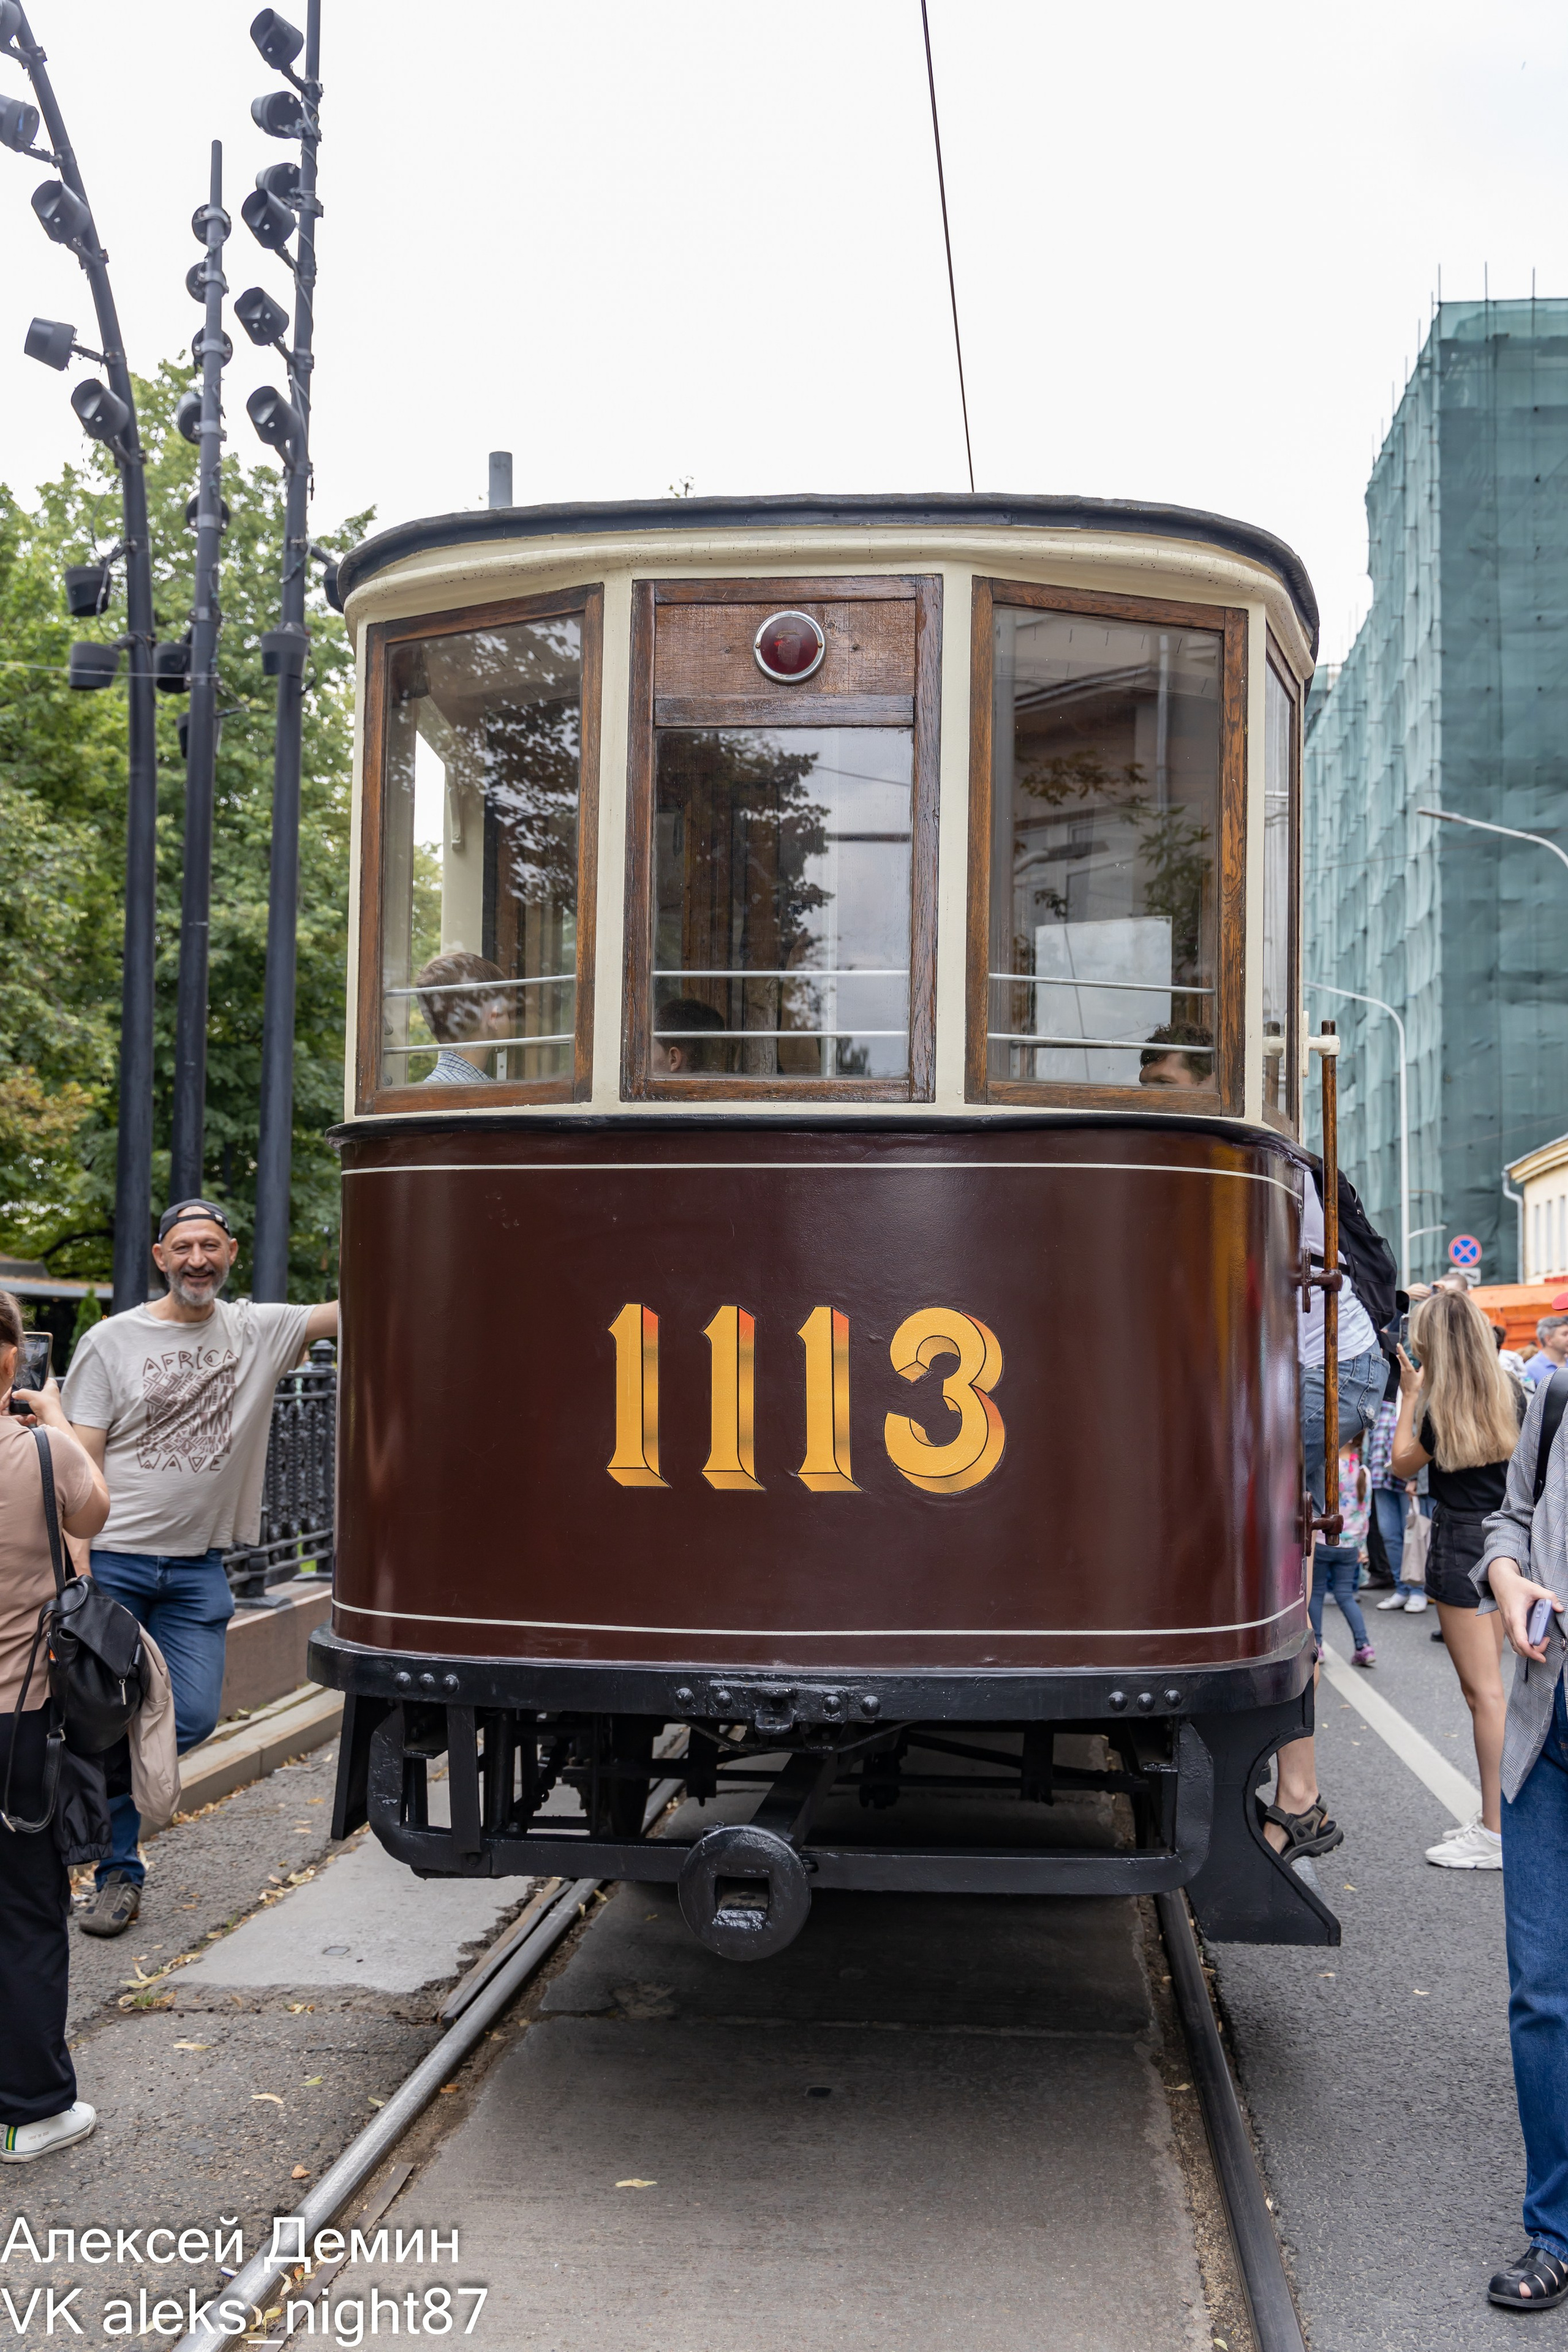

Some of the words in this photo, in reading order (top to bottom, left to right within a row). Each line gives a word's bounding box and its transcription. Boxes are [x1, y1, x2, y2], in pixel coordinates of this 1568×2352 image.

[143, 1346, 239, 1376] AFRICA
[605, 1303, 1006, 1494] 1113
[137, 1452, 224, 1473] WAVE
